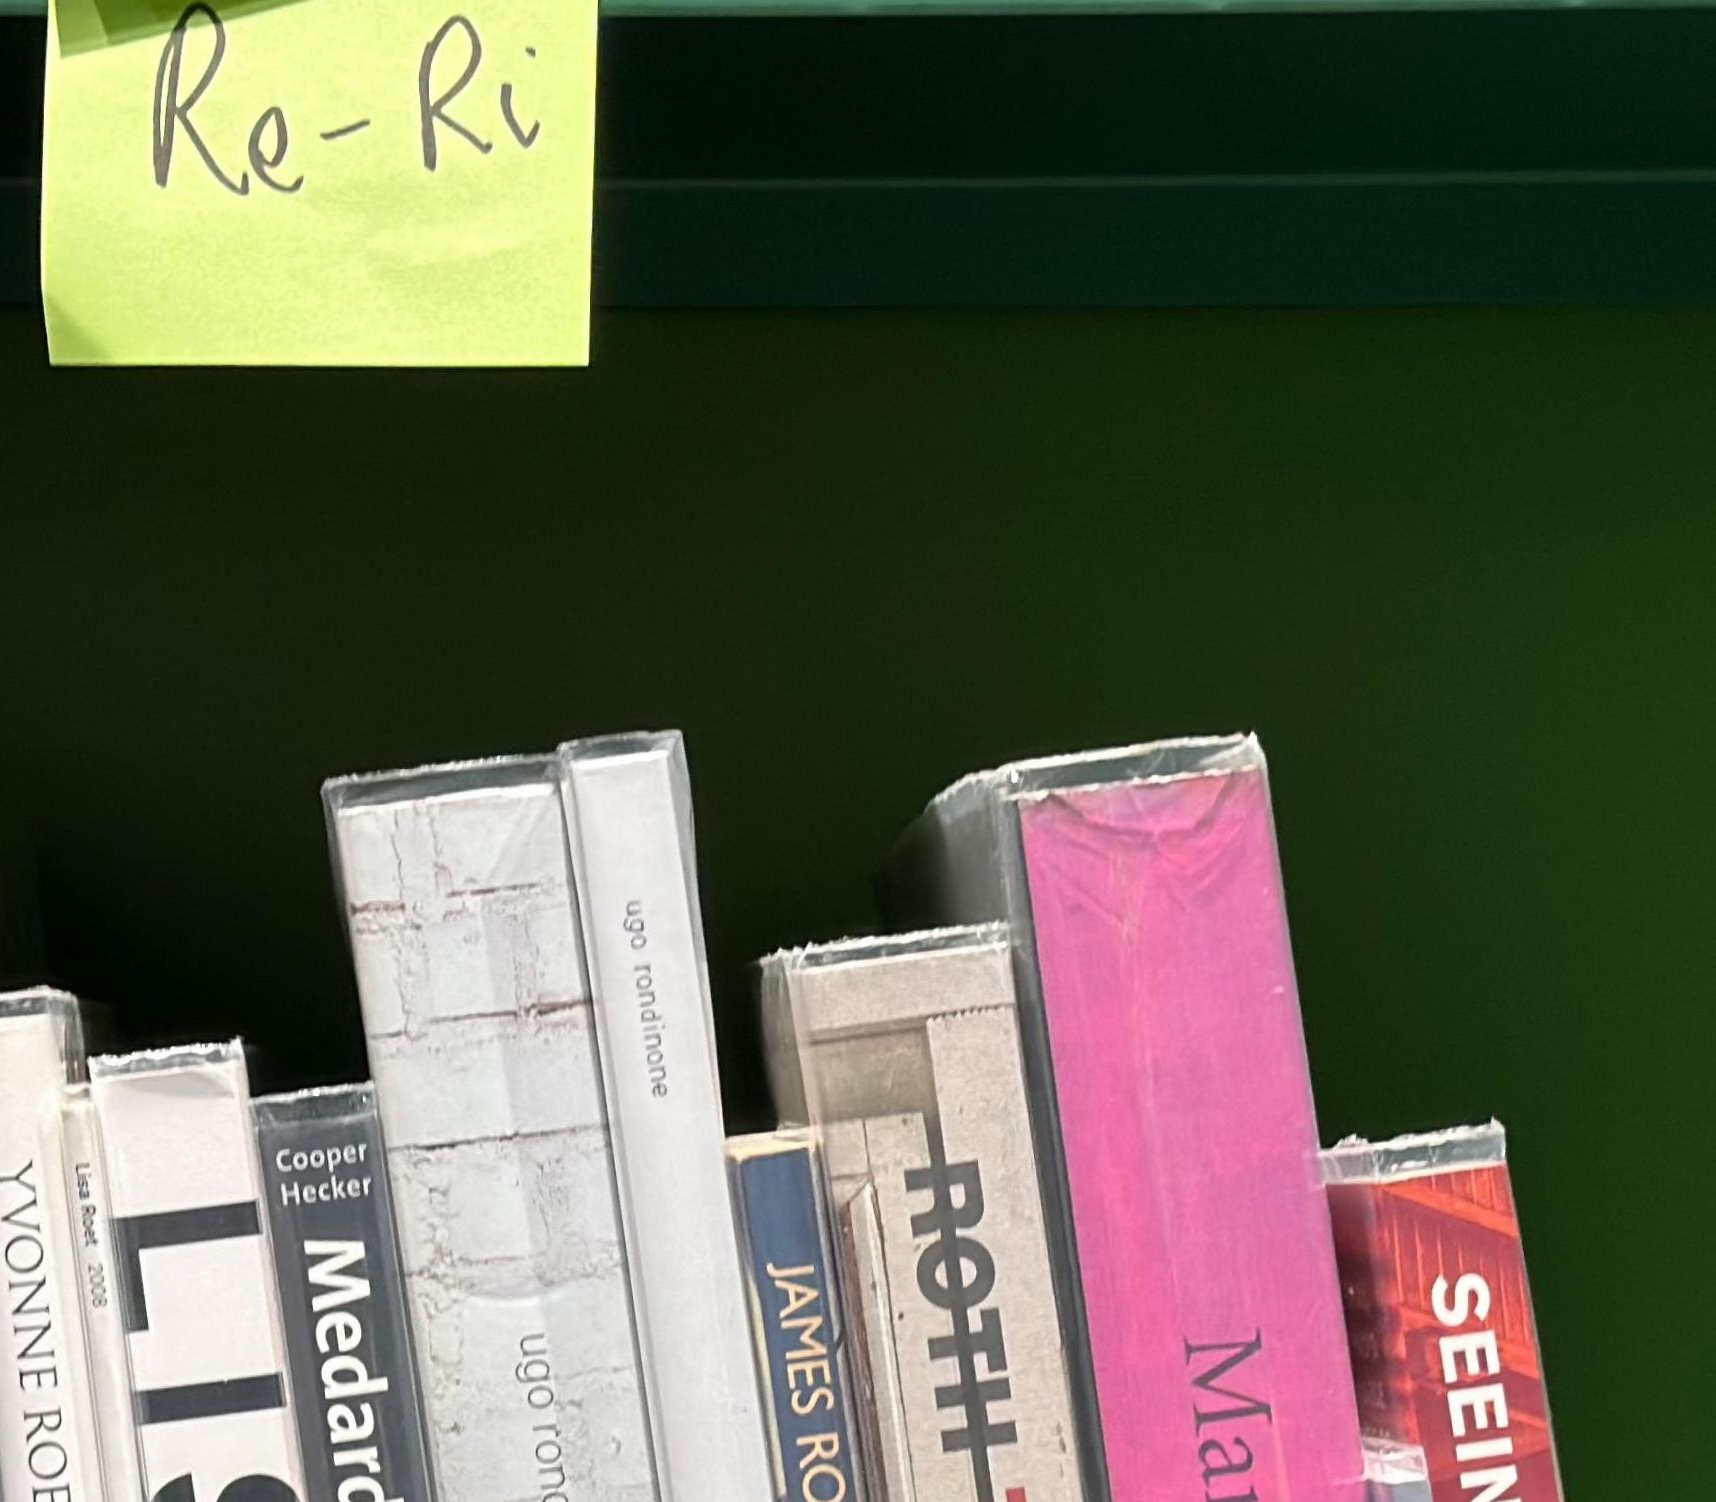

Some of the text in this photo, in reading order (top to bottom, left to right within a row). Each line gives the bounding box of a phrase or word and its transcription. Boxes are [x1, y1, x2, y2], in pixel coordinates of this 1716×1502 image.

[623, 898, 670, 1099] ugo rondinone
[75, 1162, 92, 1200] Lisa
[274, 1142, 368, 1173] Cooper
[280, 1174, 372, 1207] Hecker
[81, 1204, 99, 1248] Roet
[902, 1157, 1019, 1455] ROTH
[515, 1331, 555, 1410] ugo
[766, 1262, 836, 1418] JAMES
